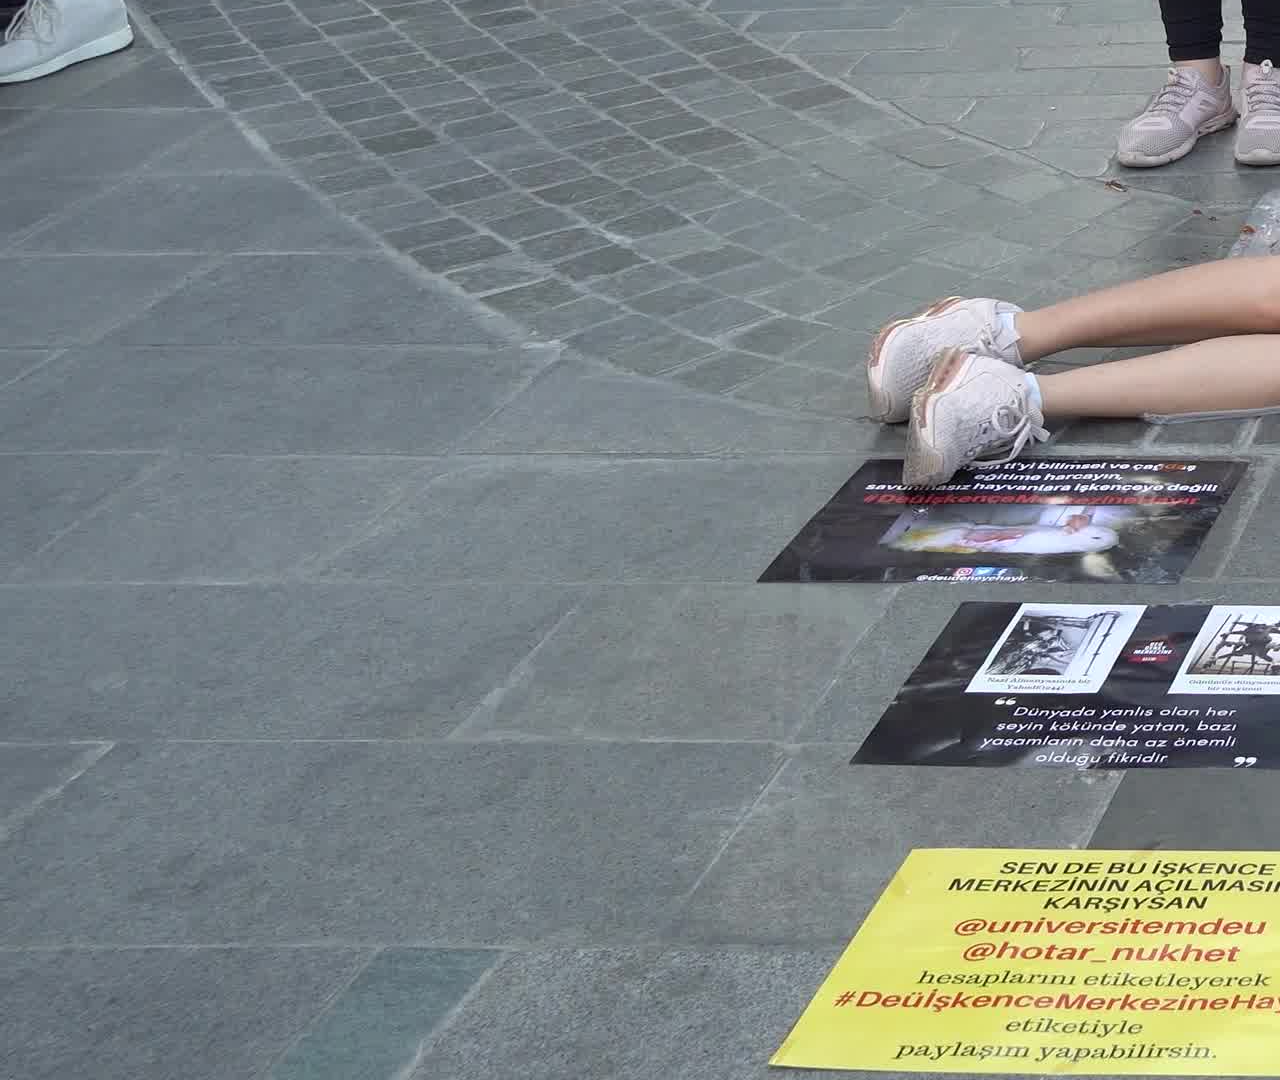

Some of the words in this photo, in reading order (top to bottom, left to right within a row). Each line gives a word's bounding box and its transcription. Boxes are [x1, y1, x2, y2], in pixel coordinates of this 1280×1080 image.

[1013, 706, 1096, 719] Dünyada
[1159, 705, 1200, 716] olan
[1205, 706, 1237, 717] her
[1049, 720, 1127, 732] kökünde
[1131, 721, 1190, 735] yatan,
[1196, 720, 1237, 731] bazı
[1089, 735, 1139, 747] daha
[1144, 739, 1168, 748] az
[1173, 735, 1237, 748] önemli
[1035, 751, 1101, 766] olduğu
[999, 861, 1060, 875] SEN
[1064, 861, 1103, 875] DE
[1108, 861, 1148, 875] BU
[1151, 859, 1277, 878] İŞKENCE
[948, 876, 1130, 893] MERKEZİNİN
[1043, 896, 1208, 914] KARŞIYSAN
[953, 918, 1267, 937] @universitemdeu
[962, 942, 1240, 964] @hotar_nukhet
[916, 970, 1076, 989] hesaplarını
[1082, 971, 1272, 990] etiketleyerek
[1004, 1018, 1143, 1039] etiketiyle
[894, 1041, 1031, 1062] paylaşım
[1035, 1041, 1217, 1064] yapabilirsin.
